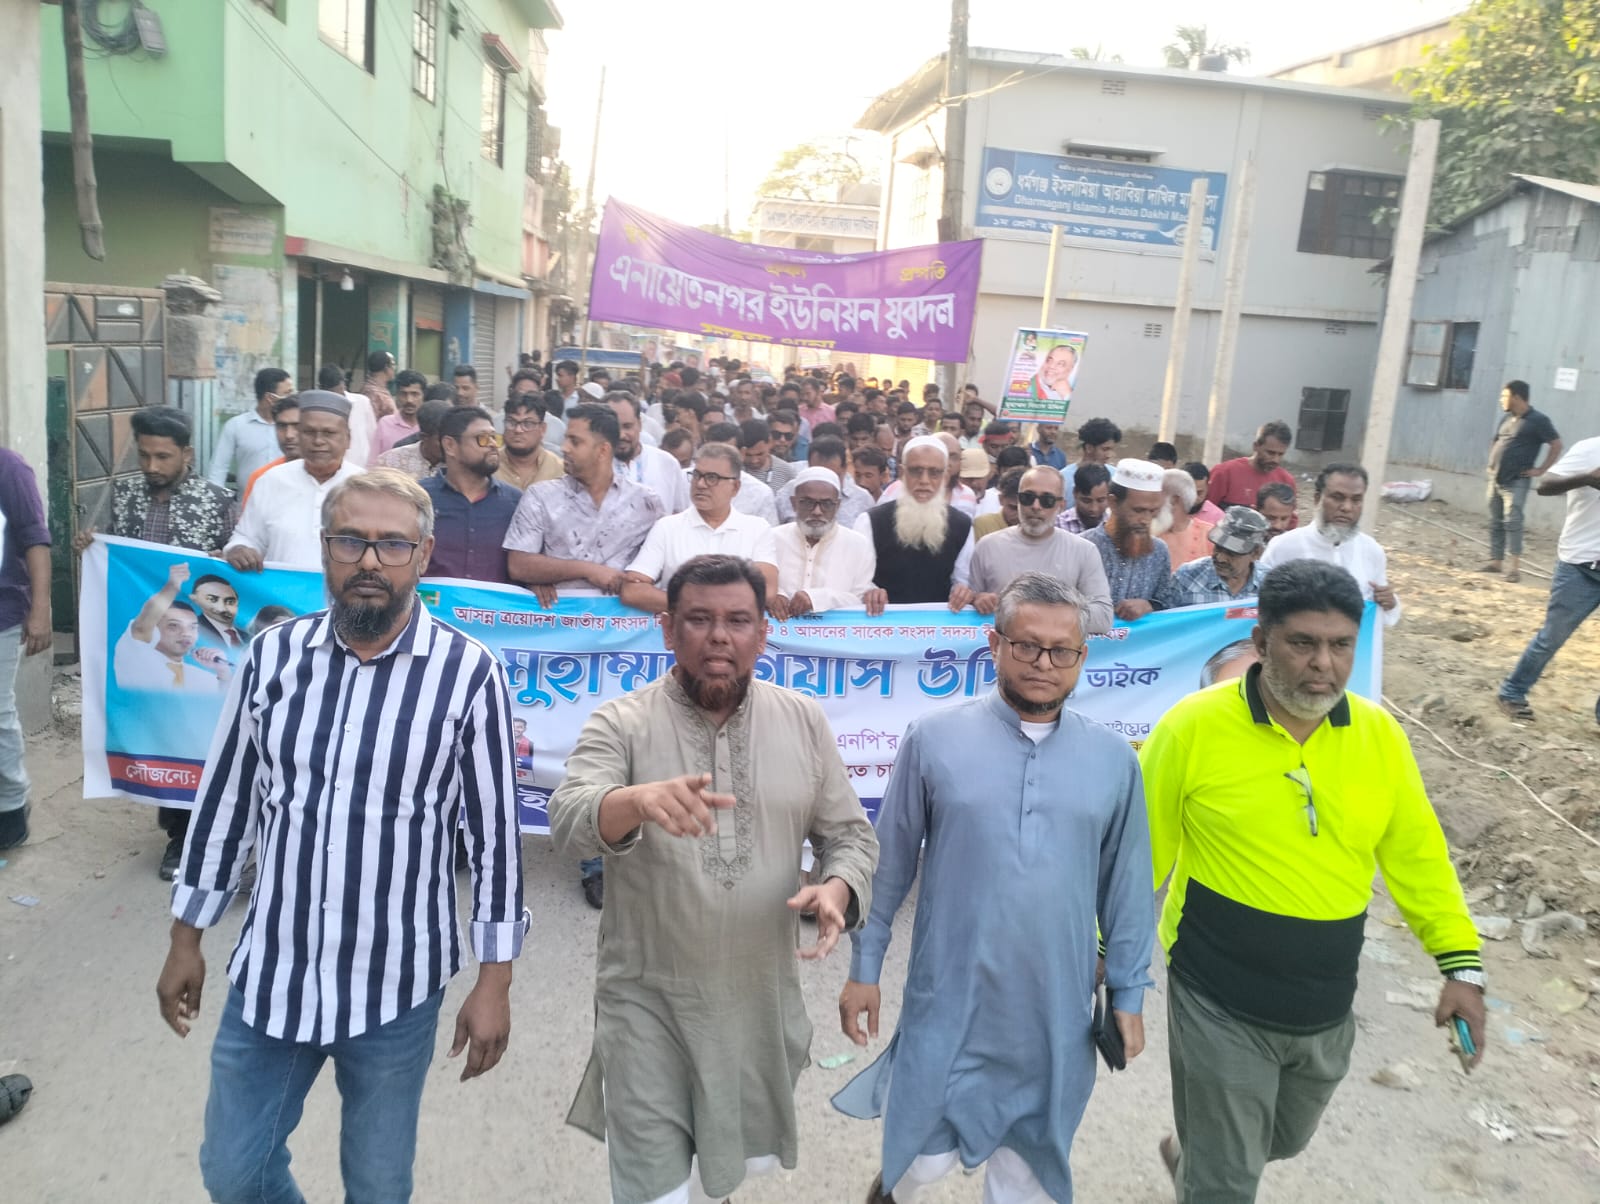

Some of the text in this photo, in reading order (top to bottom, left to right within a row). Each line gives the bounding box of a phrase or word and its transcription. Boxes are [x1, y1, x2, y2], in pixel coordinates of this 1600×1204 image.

[1108, 204, 1138, 217] Arabia
[609, 254, 956, 340] এনায়েতনগর ইউনিয়ন যুবদল
[454, 607, 496, 626] আসন্ন
[500, 610, 556, 628] ত্রয়োদশ
[560, 612, 607, 630] জাতীয়
[611, 615, 649, 631] সংসদ
[794, 624, 848, 639] আসনের
[852, 625, 893, 639] সাবেক
[898, 625, 937, 639] সংসদ
[941, 625, 979, 640] সদস্য
[1084, 663, 1162, 688] ভাইকে
[837, 728, 900, 750] এনপি'র
